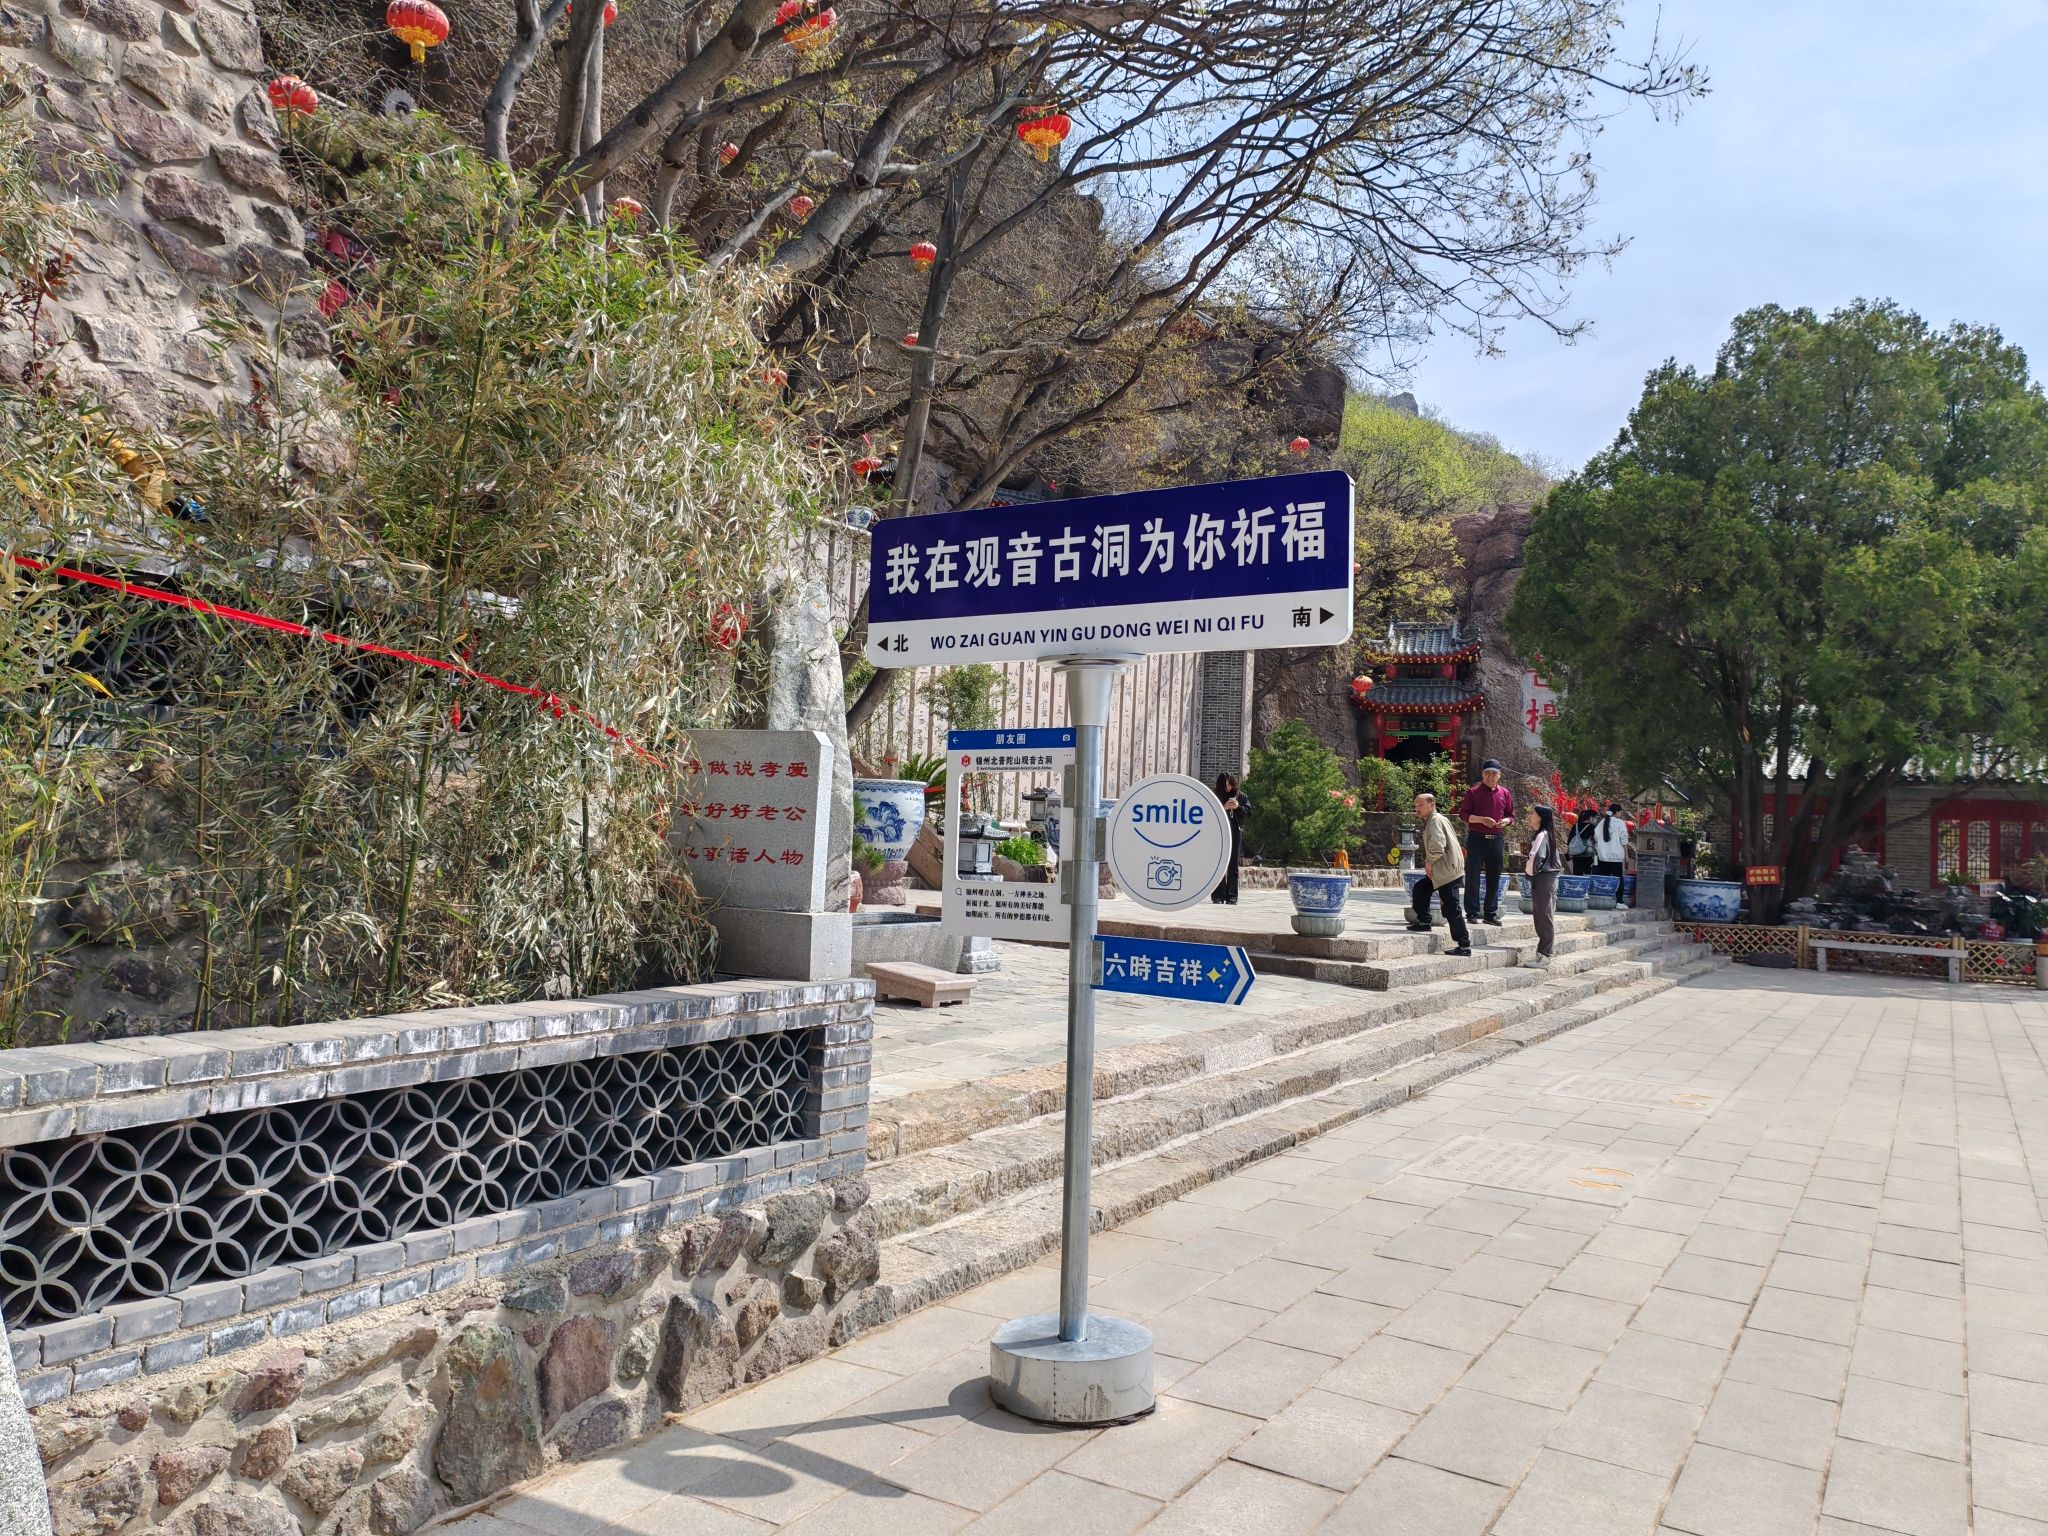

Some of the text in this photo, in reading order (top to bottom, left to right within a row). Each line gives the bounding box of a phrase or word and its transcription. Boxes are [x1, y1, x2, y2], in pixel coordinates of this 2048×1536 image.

[885, 501, 1326, 595] 我在观音古洞为你祈福
[1291, 606, 1312, 628] 南
[893, 634, 909, 653] 北
[930, 614, 1264, 650] WO ZAI GUAN YIN GU DONG WEI NI QI FU
[995, 733, 1026, 745] 朋友圈
[975, 755, 1053, 766] 锦州北普陀山观音古洞
[1131, 798, 1204, 825] smile
[1105, 953, 1203, 987] 六時吉祥
